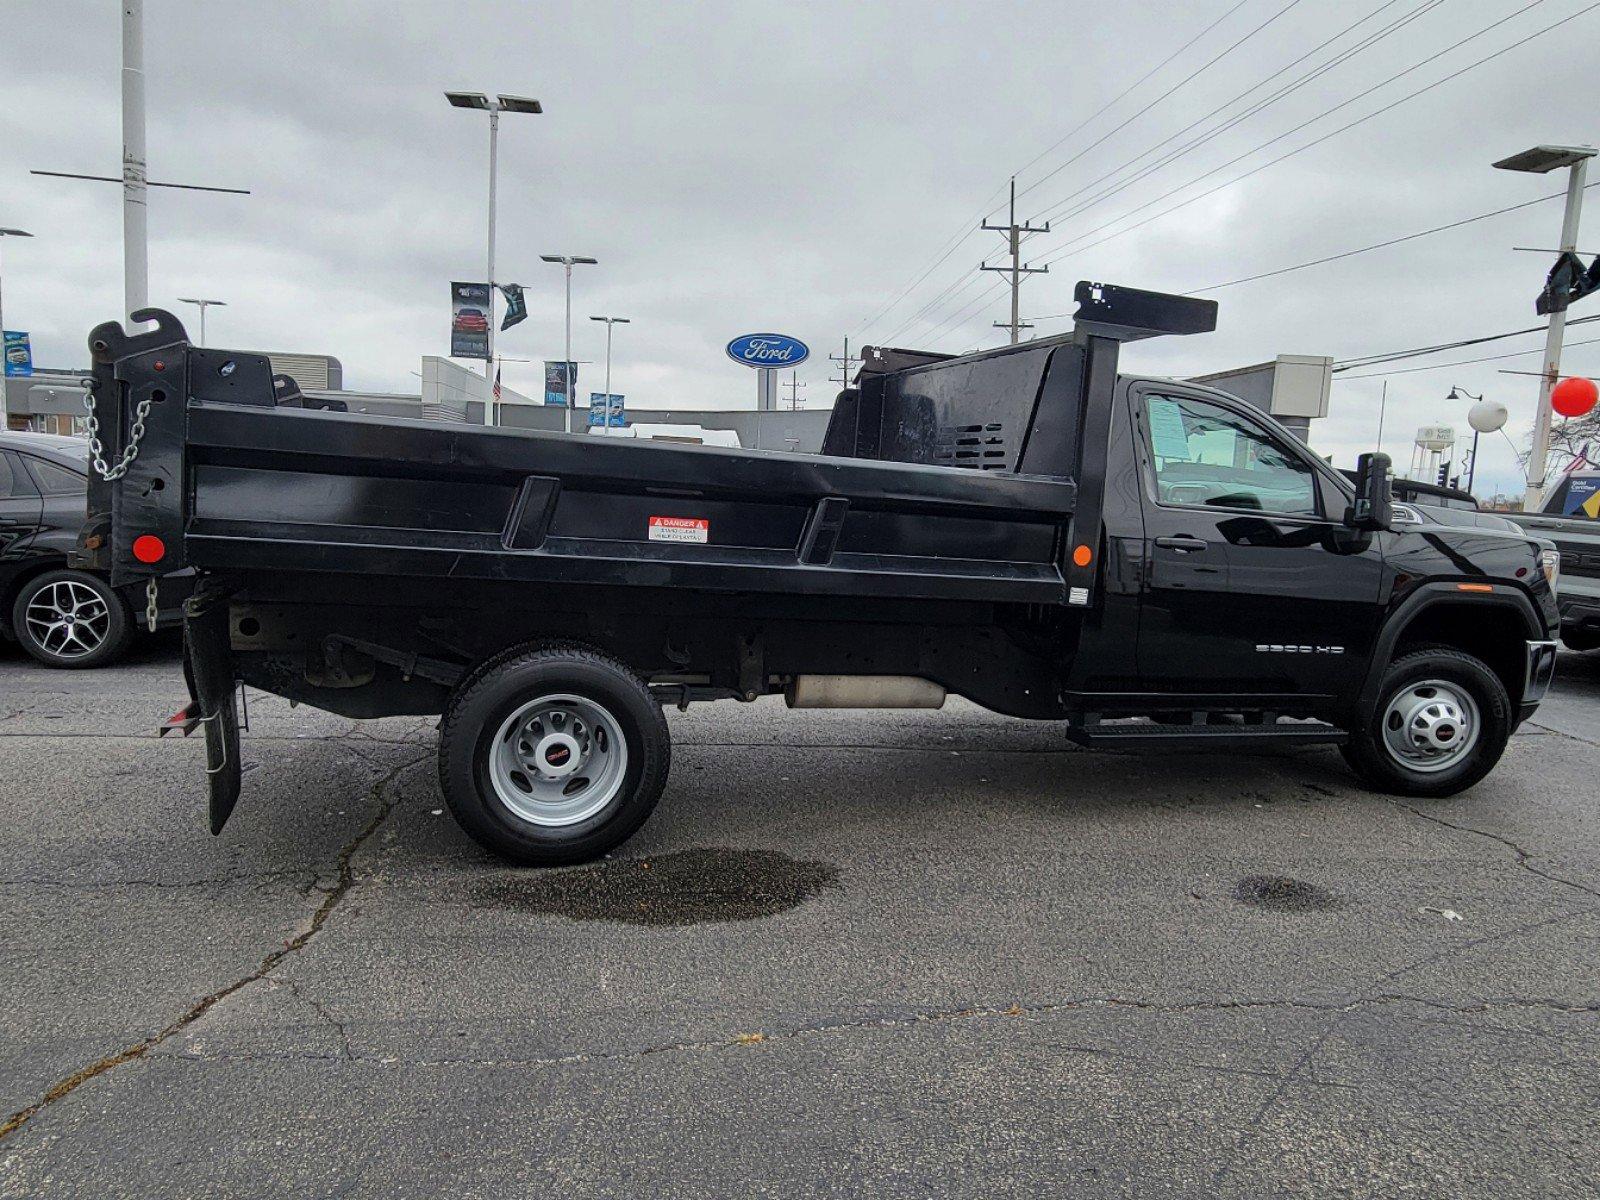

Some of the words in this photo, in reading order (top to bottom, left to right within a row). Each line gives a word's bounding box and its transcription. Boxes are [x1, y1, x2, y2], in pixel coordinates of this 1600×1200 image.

[744, 338, 794, 360] Ford
[663, 519, 695, 527] DANGER
[1316, 645, 1345, 654] HD
[547, 749, 569, 761] GMC
